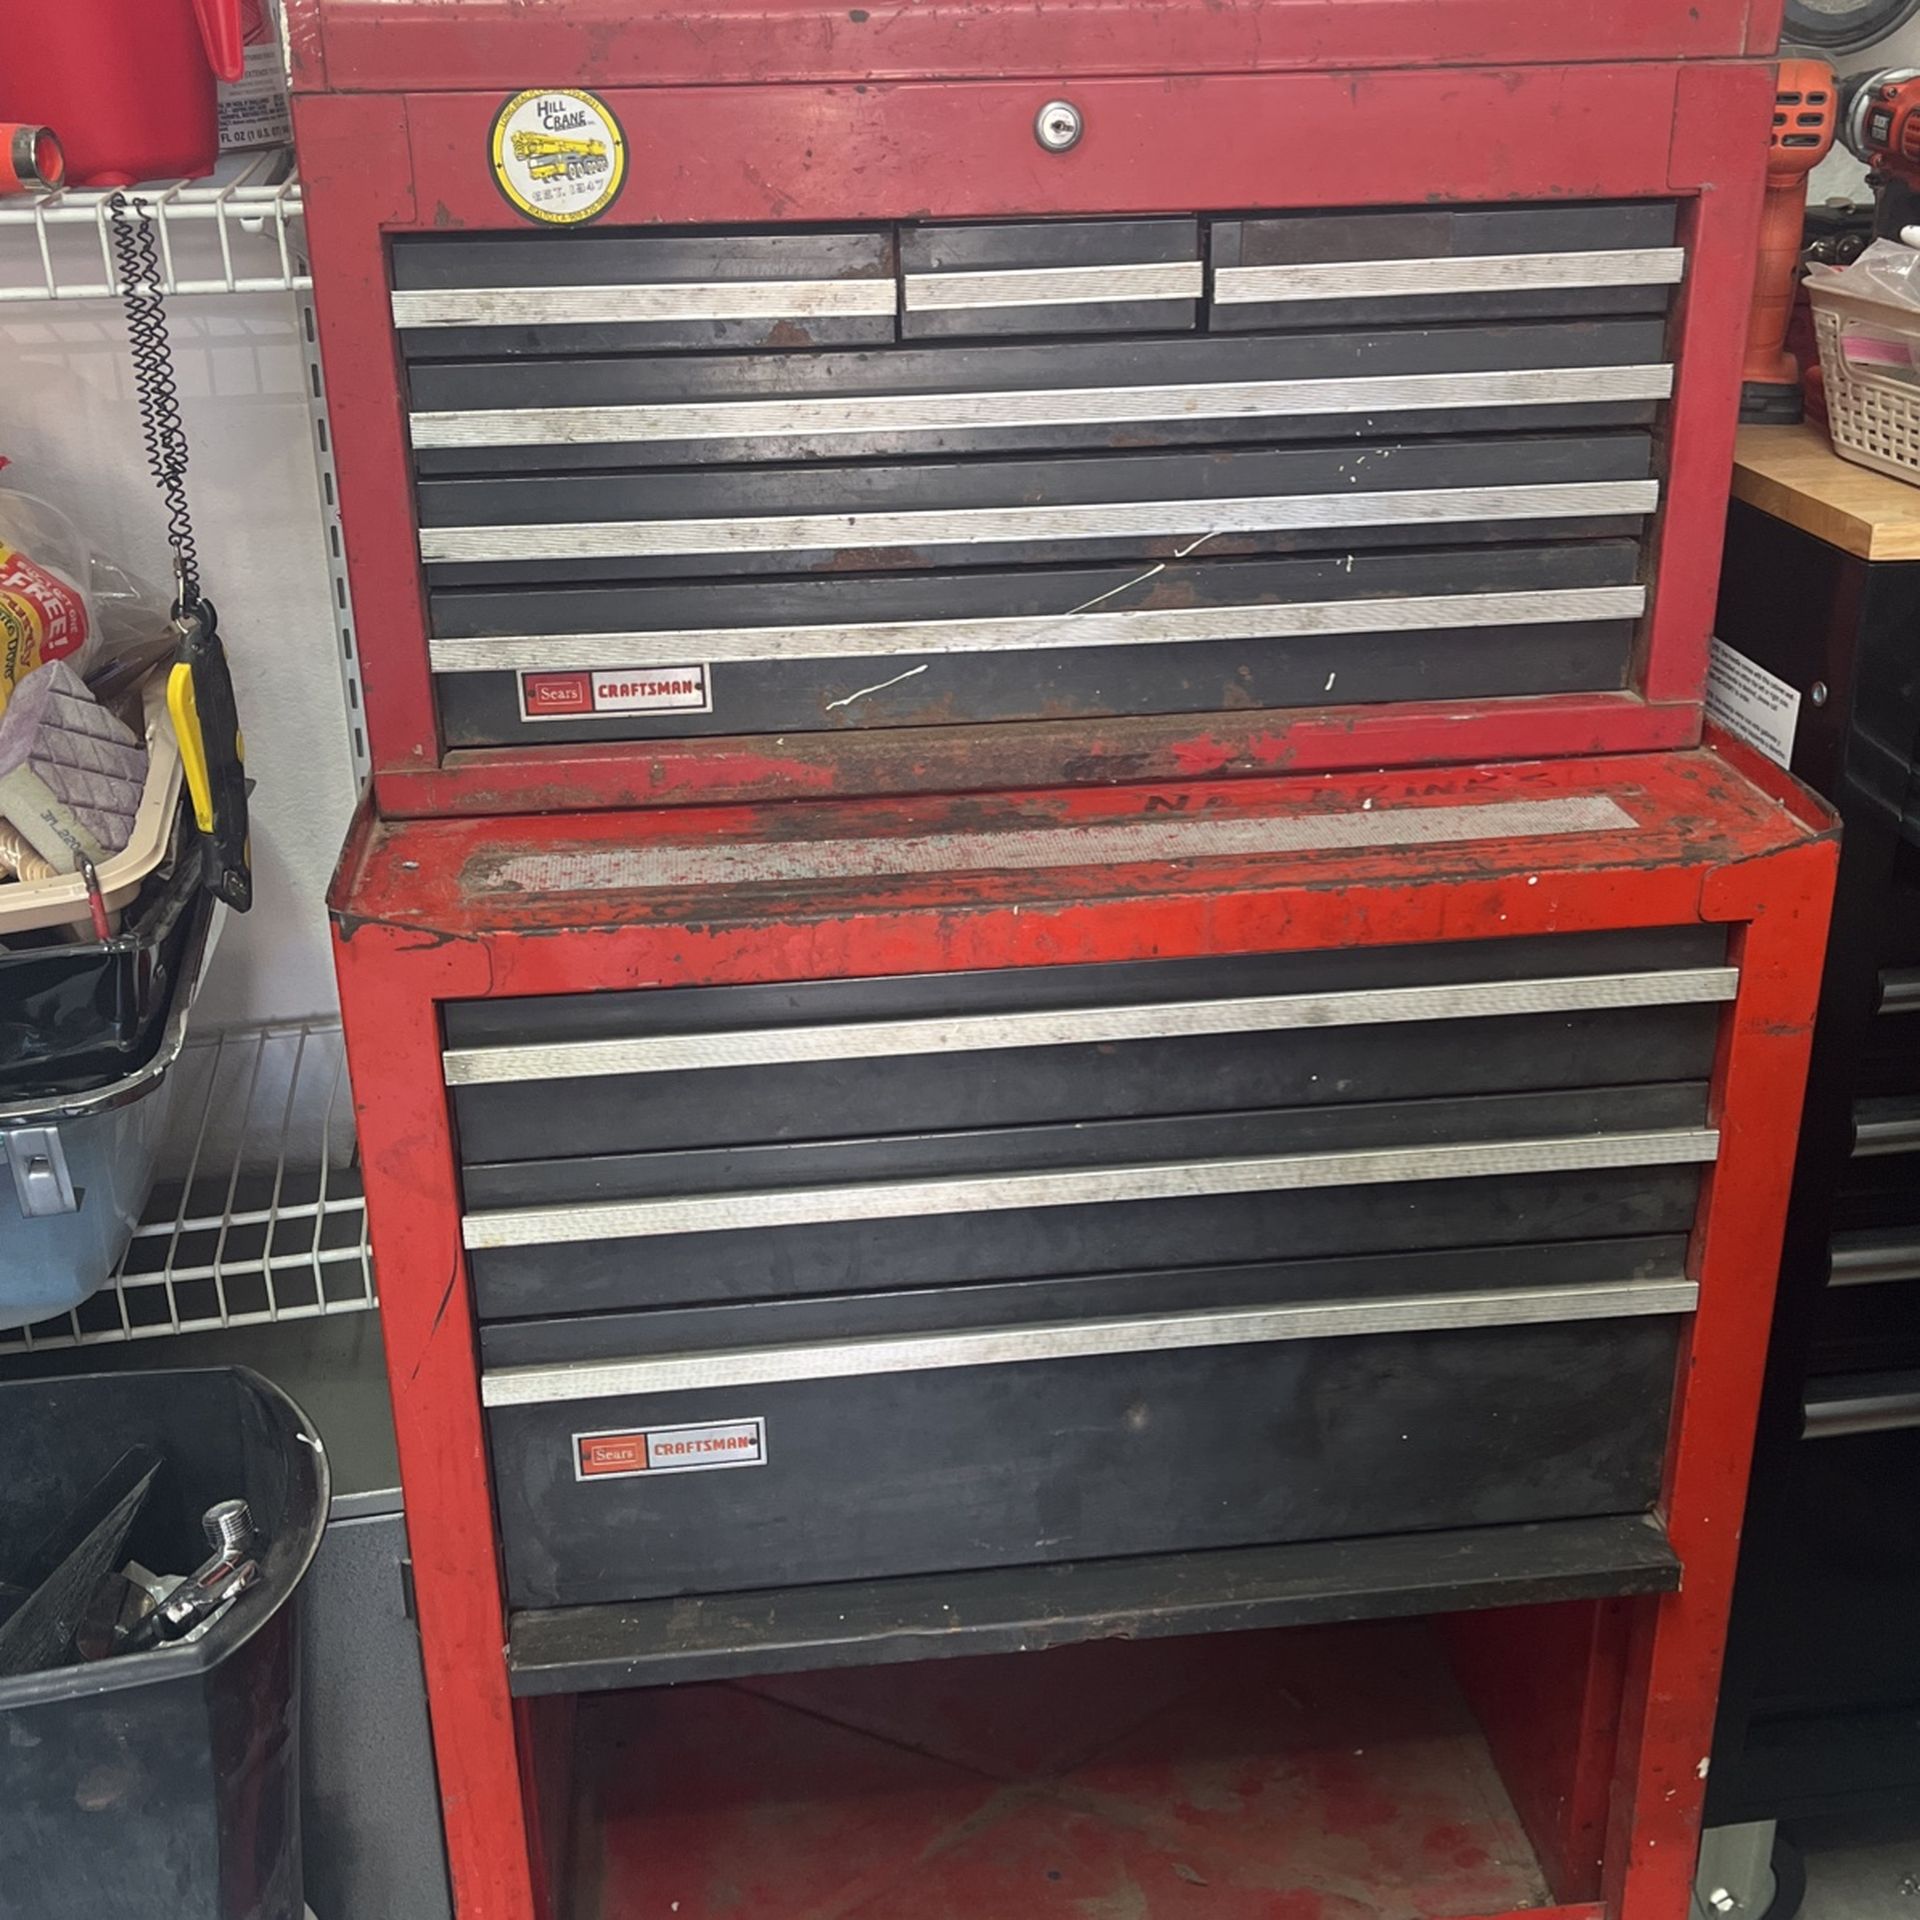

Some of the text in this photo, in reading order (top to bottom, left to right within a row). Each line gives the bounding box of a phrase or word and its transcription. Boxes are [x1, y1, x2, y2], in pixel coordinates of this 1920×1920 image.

[537, 100, 567, 117] HILL
[543, 110, 585, 130] CRANE
[234, 130, 246, 141] OZ
[2, 571, 69, 650] FREE!
[540, 680, 693, 701] Sears CRAFTSMAN
[595, 1436, 750, 1462] Sears CRAFTSMAN
